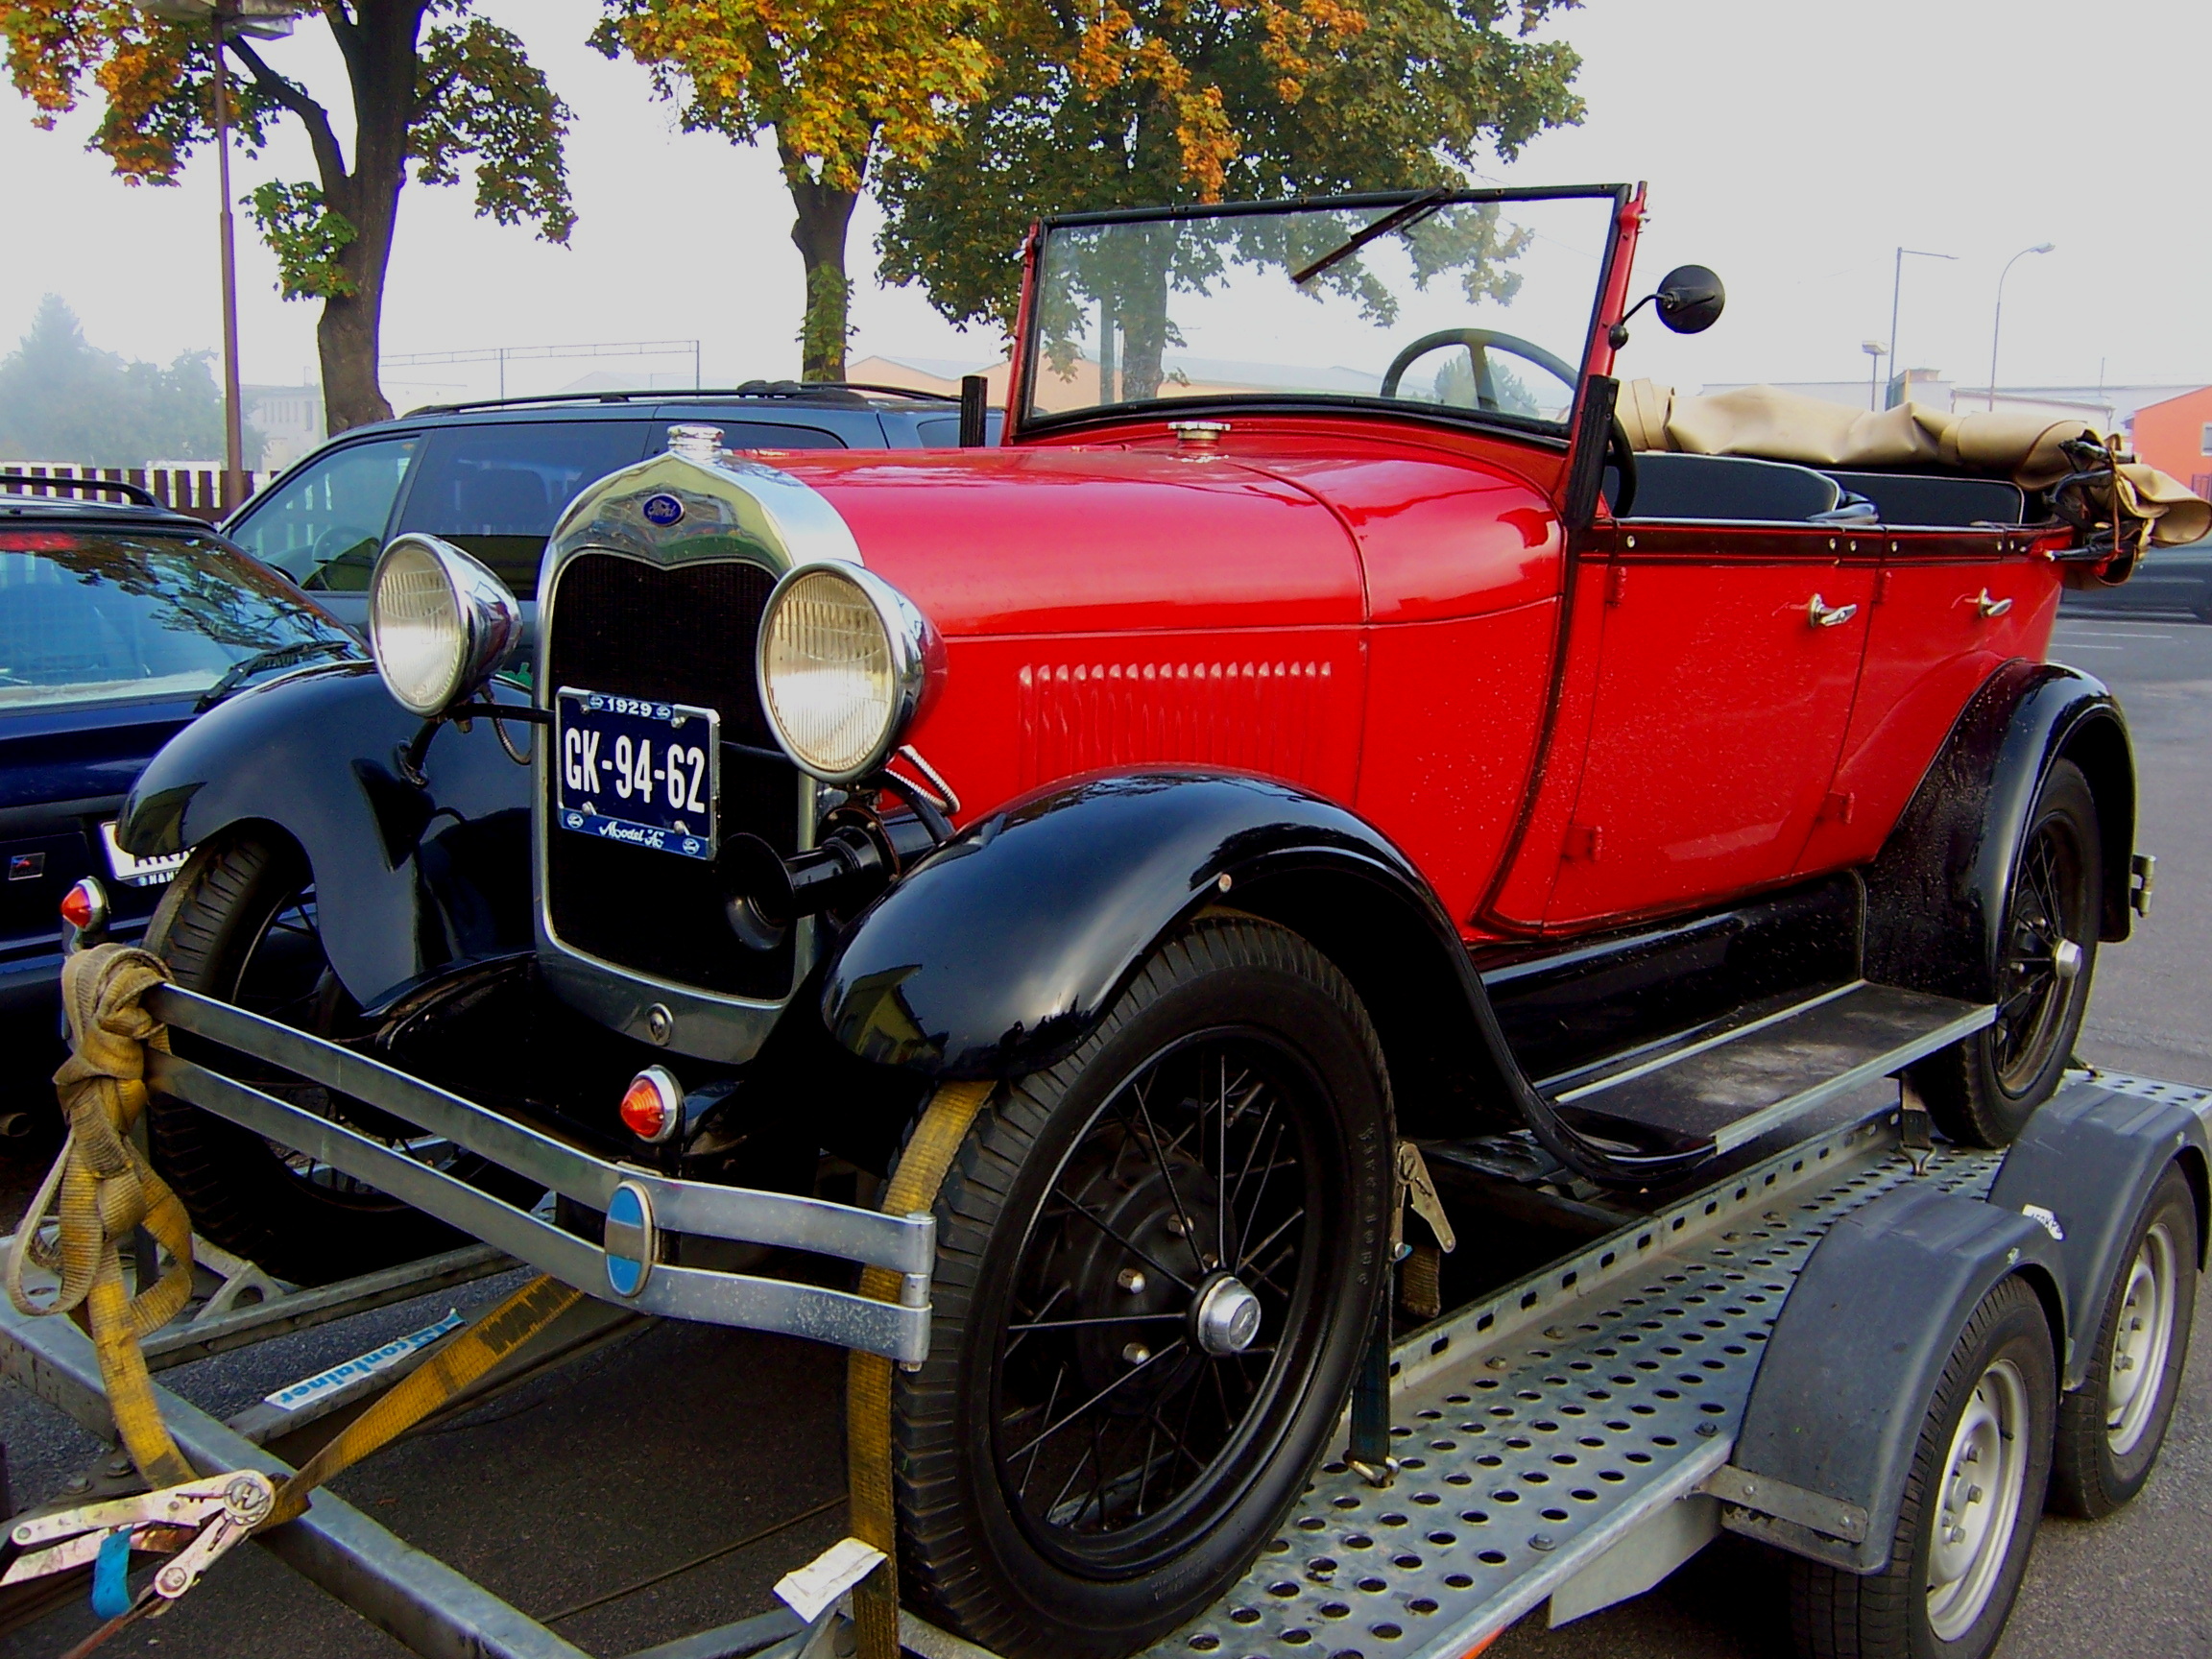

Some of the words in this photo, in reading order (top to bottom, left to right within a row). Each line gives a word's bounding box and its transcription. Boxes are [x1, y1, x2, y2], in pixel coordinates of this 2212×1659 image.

[607, 697, 653, 718] 1929
[565, 727, 706, 814] GK-94-62
[598, 821, 644, 843] Model
